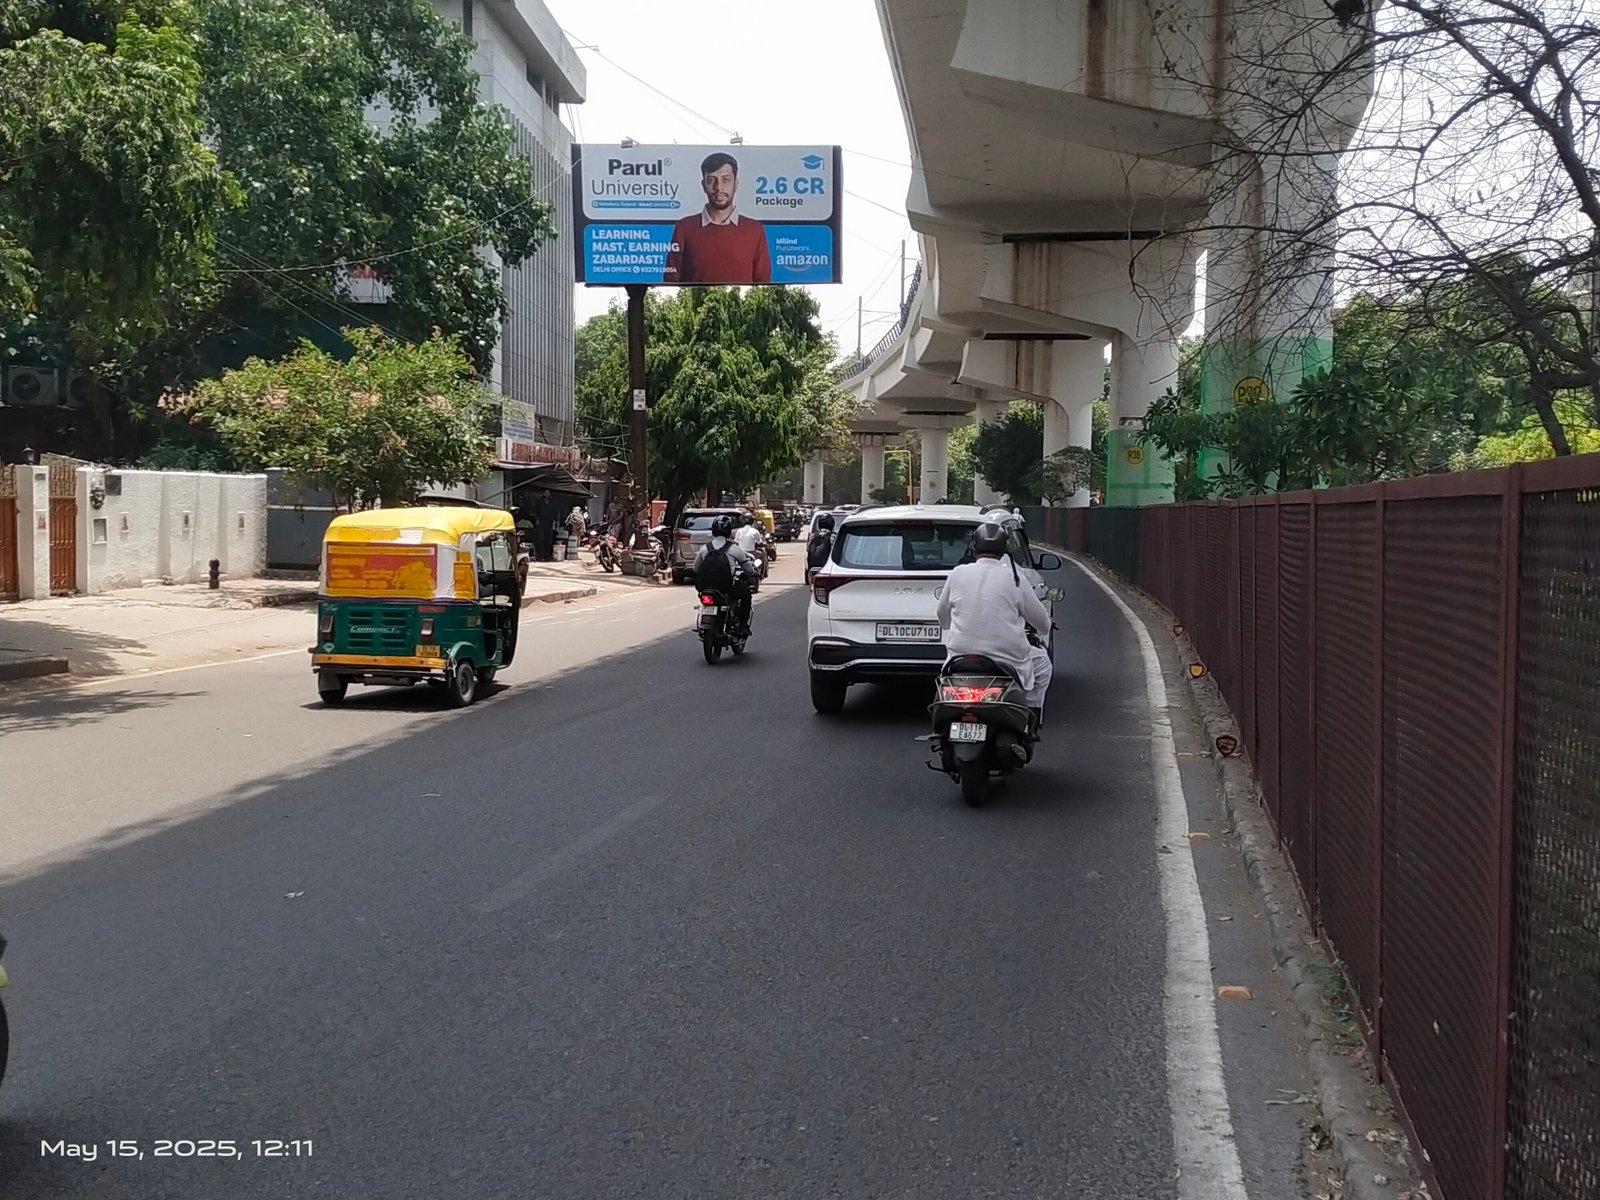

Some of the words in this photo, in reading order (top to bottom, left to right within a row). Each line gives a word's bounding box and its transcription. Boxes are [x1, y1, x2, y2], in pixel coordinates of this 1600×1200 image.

[592, 179, 679, 199] University
[756, 176, 788, 195] 2.6
[793, 177, 825, 195] CR
[755, 196, 804, 209] Package
[592, 229, 651, 240] LEARNING
[592, 242, 627, 254] MAST,
[628, 242, 680, 252] EARNING
[592, 254, 664, 265] ZABARDAST!
[776, 254, 829, 266] amazon
[882, 625, 940, 638] DL10CU7103
